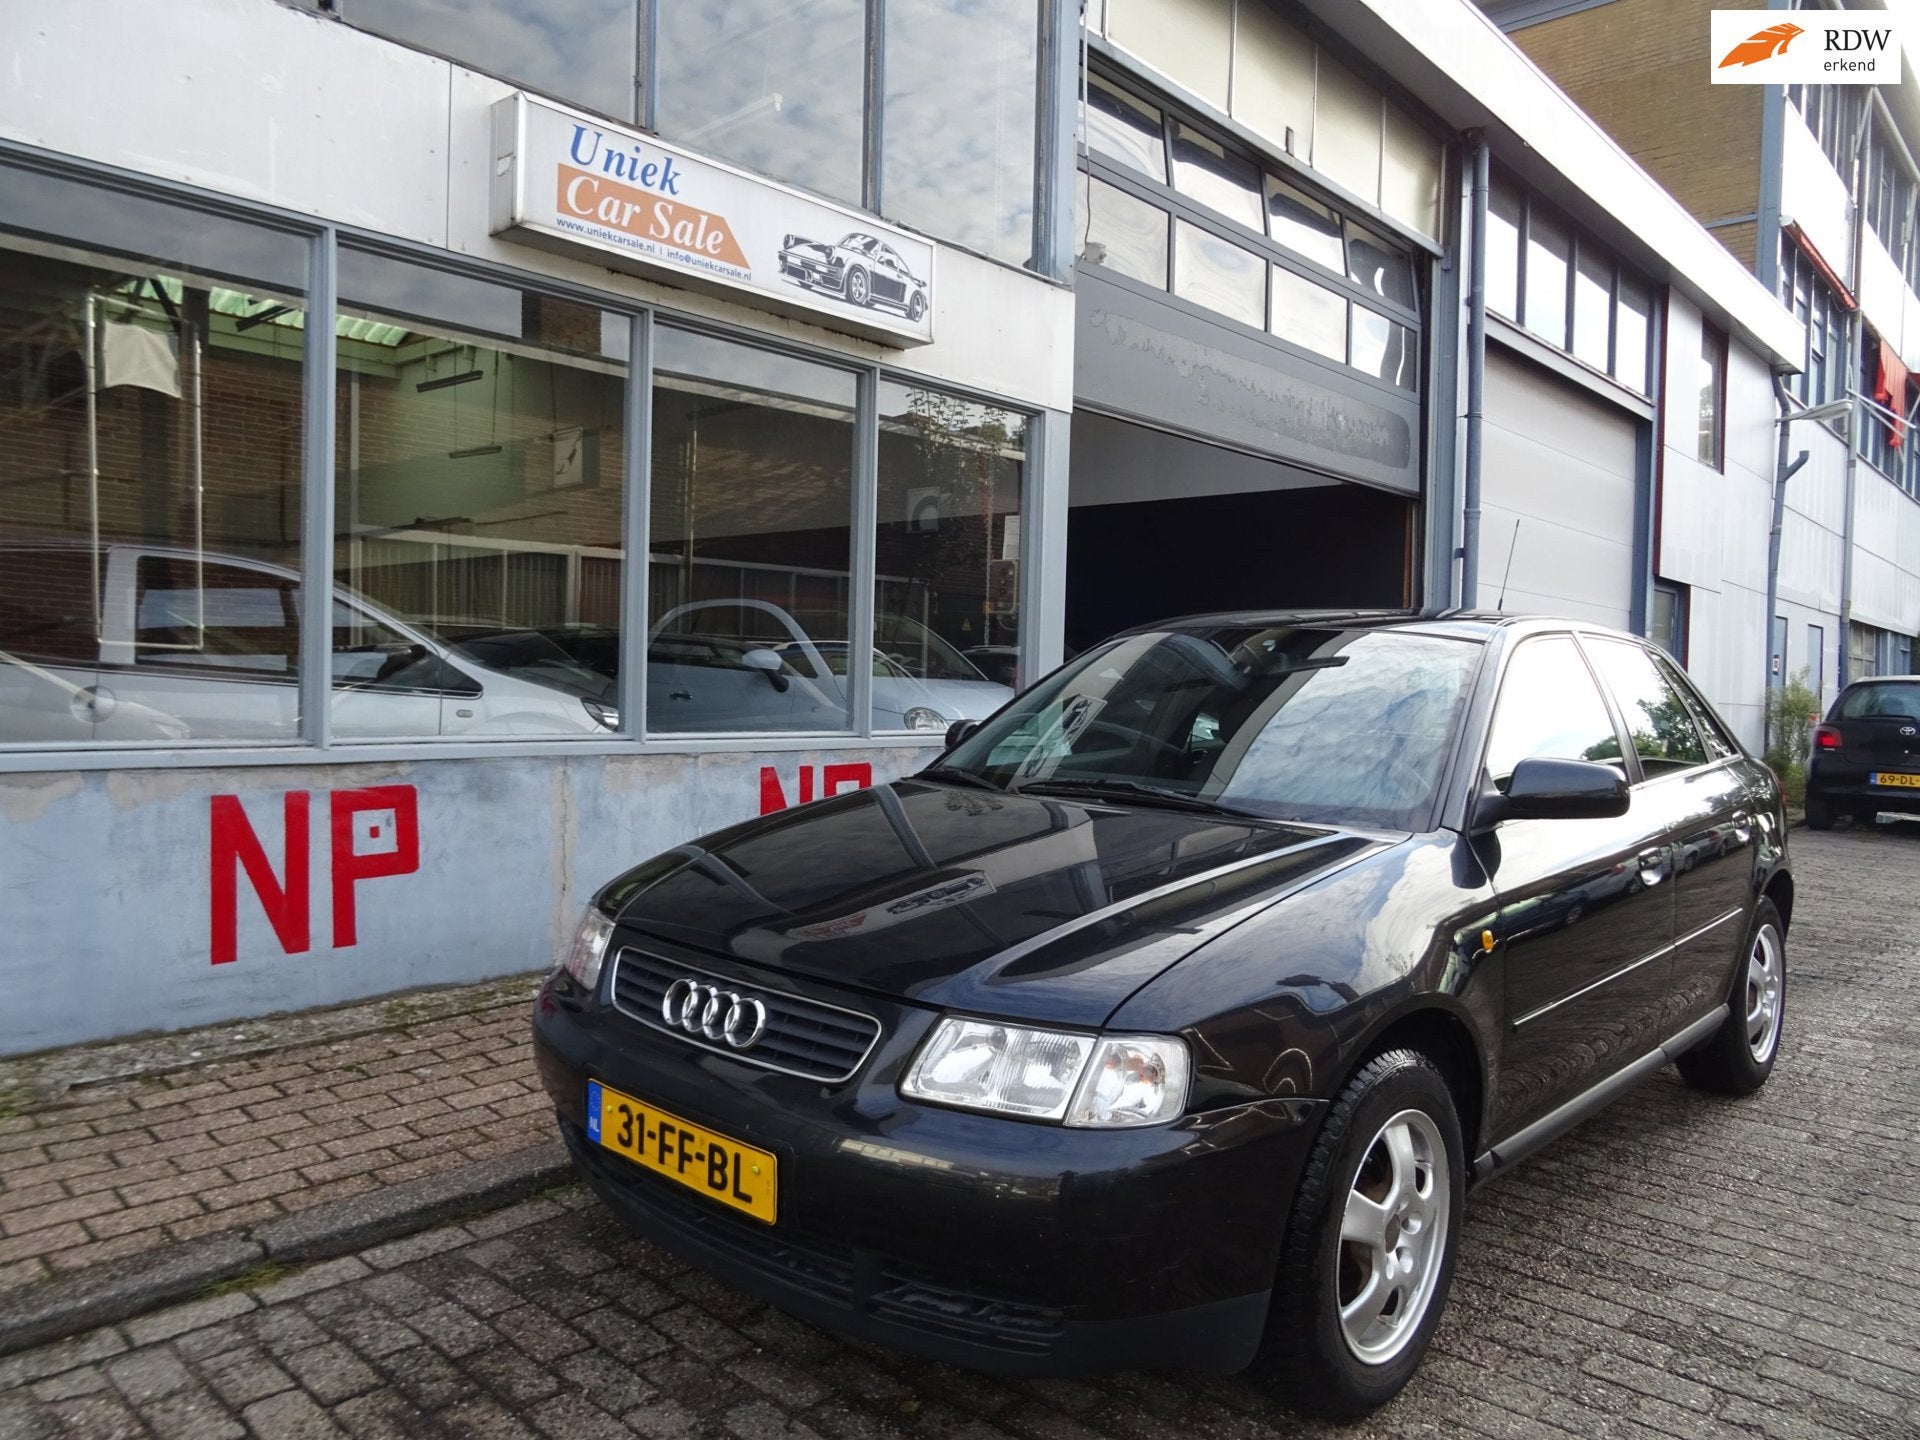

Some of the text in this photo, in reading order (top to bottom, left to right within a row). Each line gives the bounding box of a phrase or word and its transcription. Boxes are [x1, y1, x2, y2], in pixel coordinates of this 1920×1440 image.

[570, 124, 681, 195] Uniek
[556, 217, 655, 252] www.uniekcarsale.nl
[667, 249, 752, 281] info@uniekcarsale.nl
[567, 175, 724, 254] Car Sale
[210, 784, 420, 965] NP
[589, 1116, 600, 1133] NL
[617, 1103, 752, 1204] 31-FF-BL
